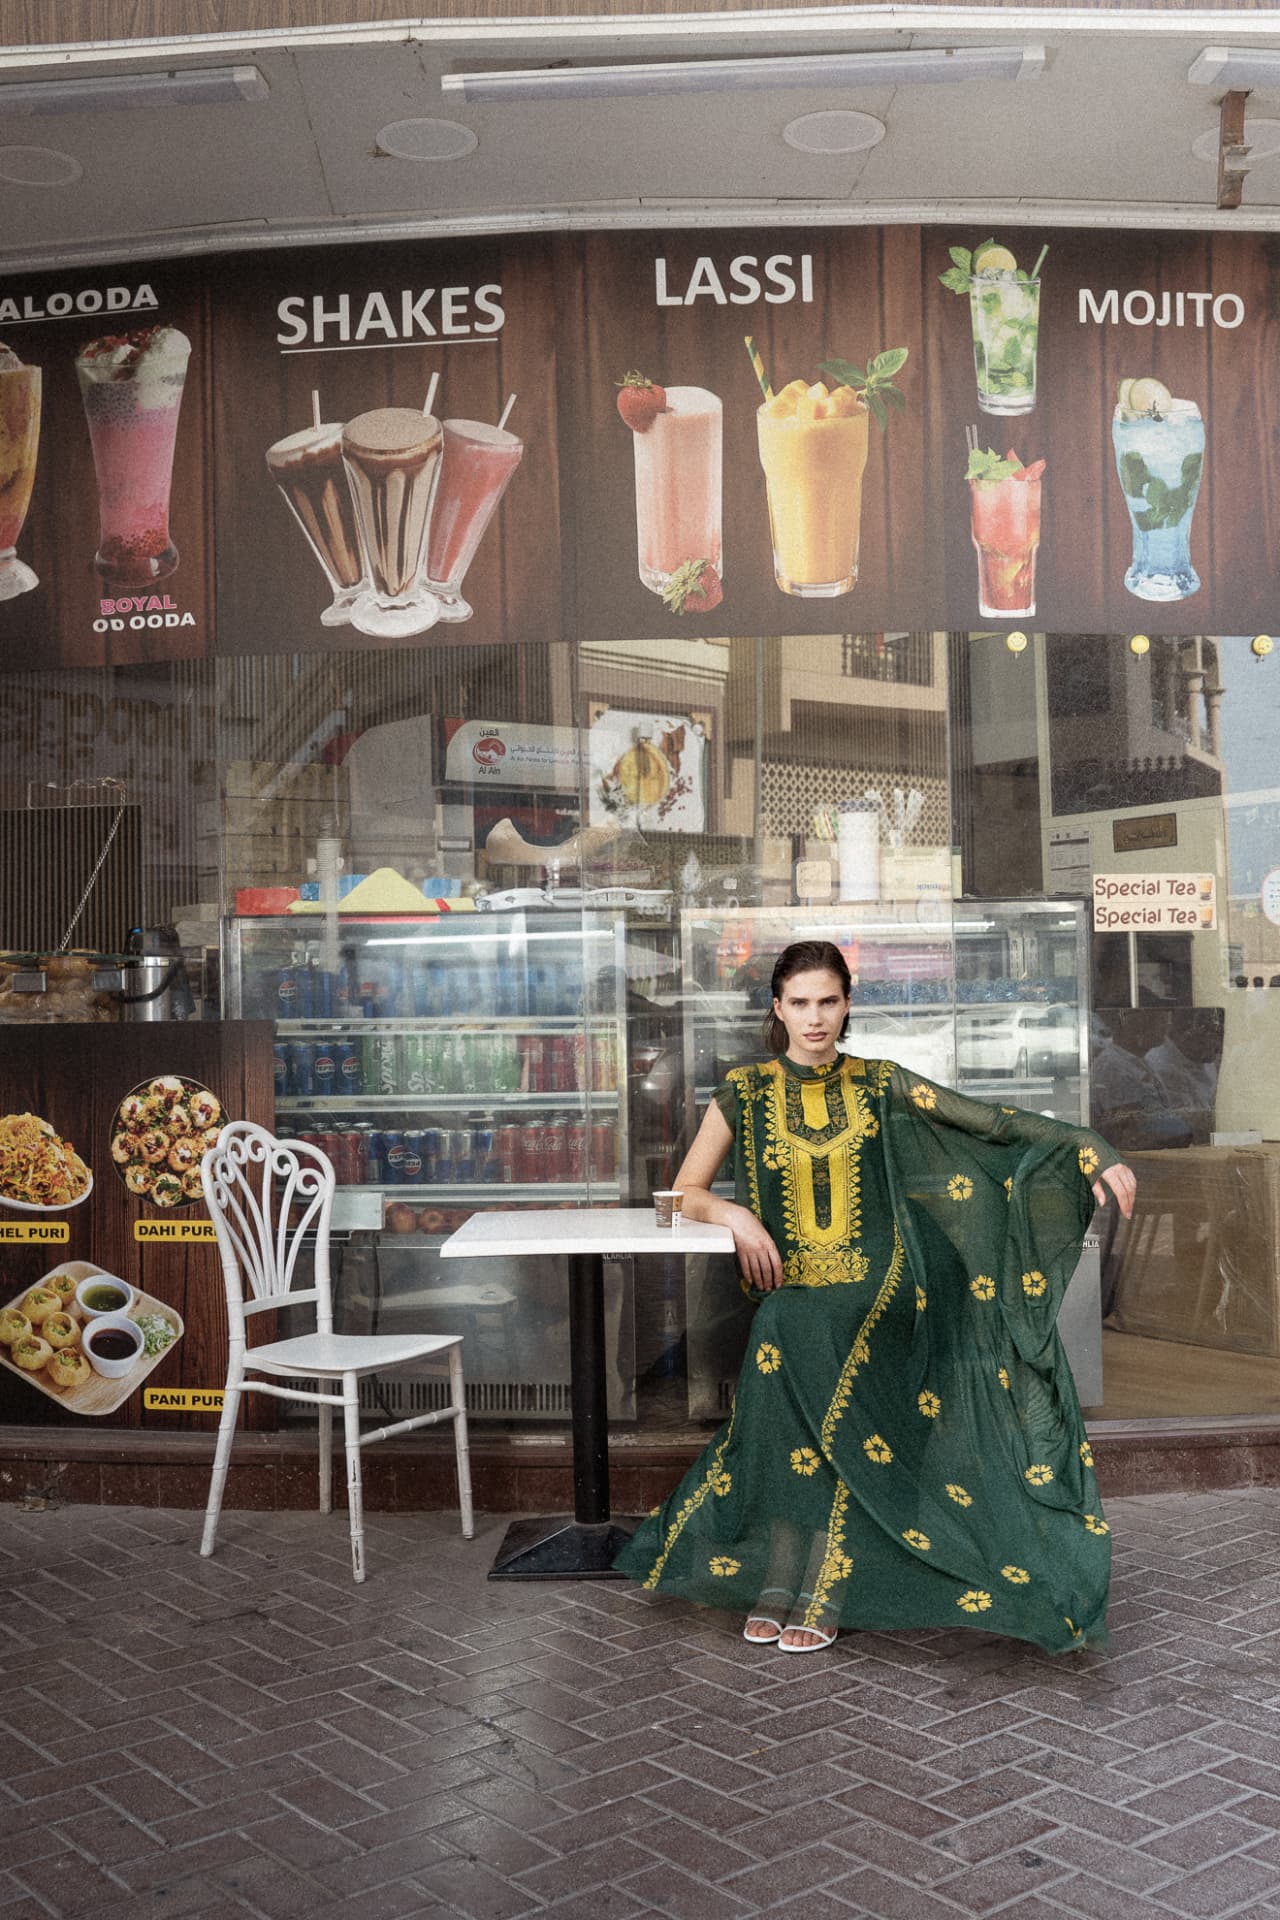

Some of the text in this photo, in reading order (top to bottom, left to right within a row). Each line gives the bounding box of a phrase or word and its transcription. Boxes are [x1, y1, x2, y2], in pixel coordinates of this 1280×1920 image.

[654, 254, 815, 307] LASSI
[0, 284, 160, 321] ALOODA
[1078, 287, 1246, 329] MOJITO
[276, 283, 505, 346] SHAKES
[1095, 878, 1197, 899] Special Tea
[1096, 906, 1197, 927] Special Tea
[28, 1227, 65, 1238] PURI
[138, 1224, 217, 1237] DAHI PUR
[149, 1393, 224, 1407] PANI PUR
